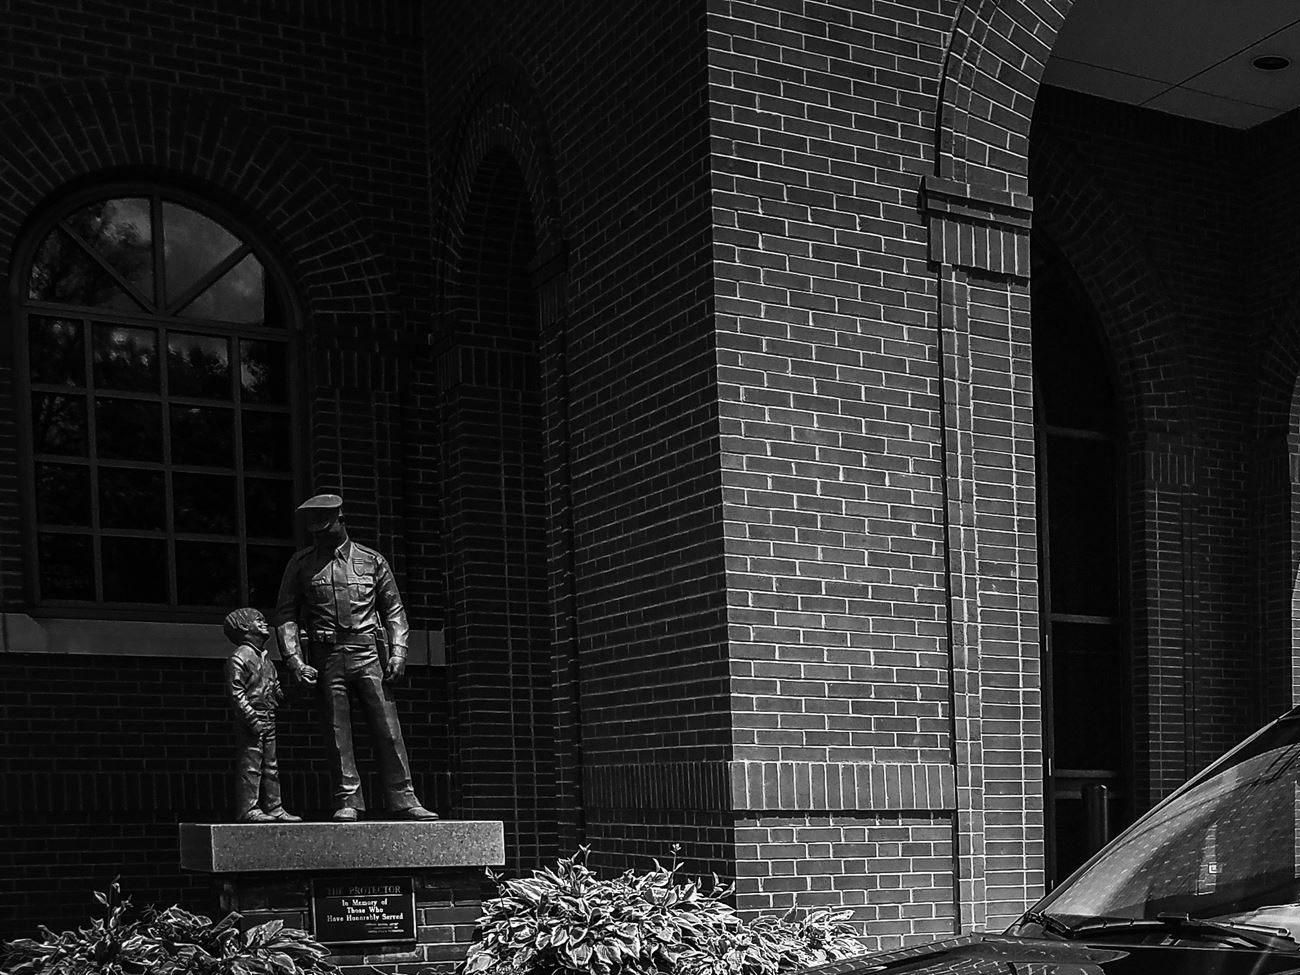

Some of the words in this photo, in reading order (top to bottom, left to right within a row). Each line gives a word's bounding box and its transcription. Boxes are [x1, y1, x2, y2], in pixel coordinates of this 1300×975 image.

[349, 885, 401, 895] PROTECTOR
[341, 899, 349, 907] In
[352, 898, 378, 907] Memory
[380, 898, 388, 906] of
[382, 912, 404, 921] Served
